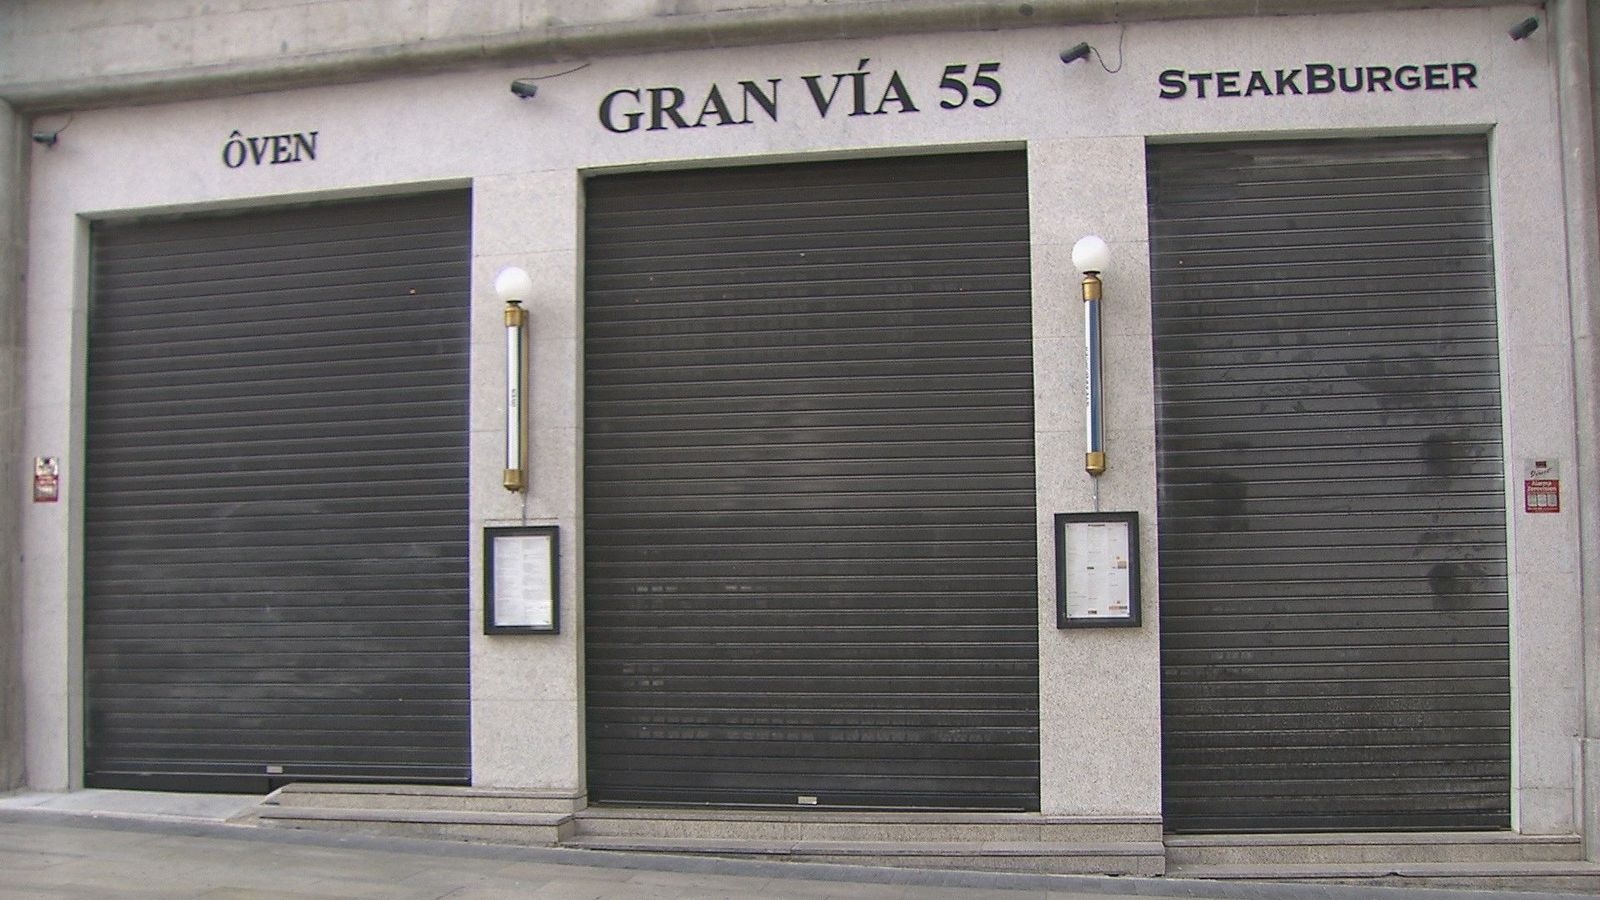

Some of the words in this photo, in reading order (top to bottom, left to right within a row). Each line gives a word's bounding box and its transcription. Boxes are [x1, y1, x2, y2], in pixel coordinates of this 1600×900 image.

[598, 78, 782, 134] GRAN
[801, 58, 921, 119] VÍA
[939, 62, 1001, 111] 55
[1158, 62, 1478, 99] STEAKBURGER
[223, 130, 319, 169] ÔVEN
